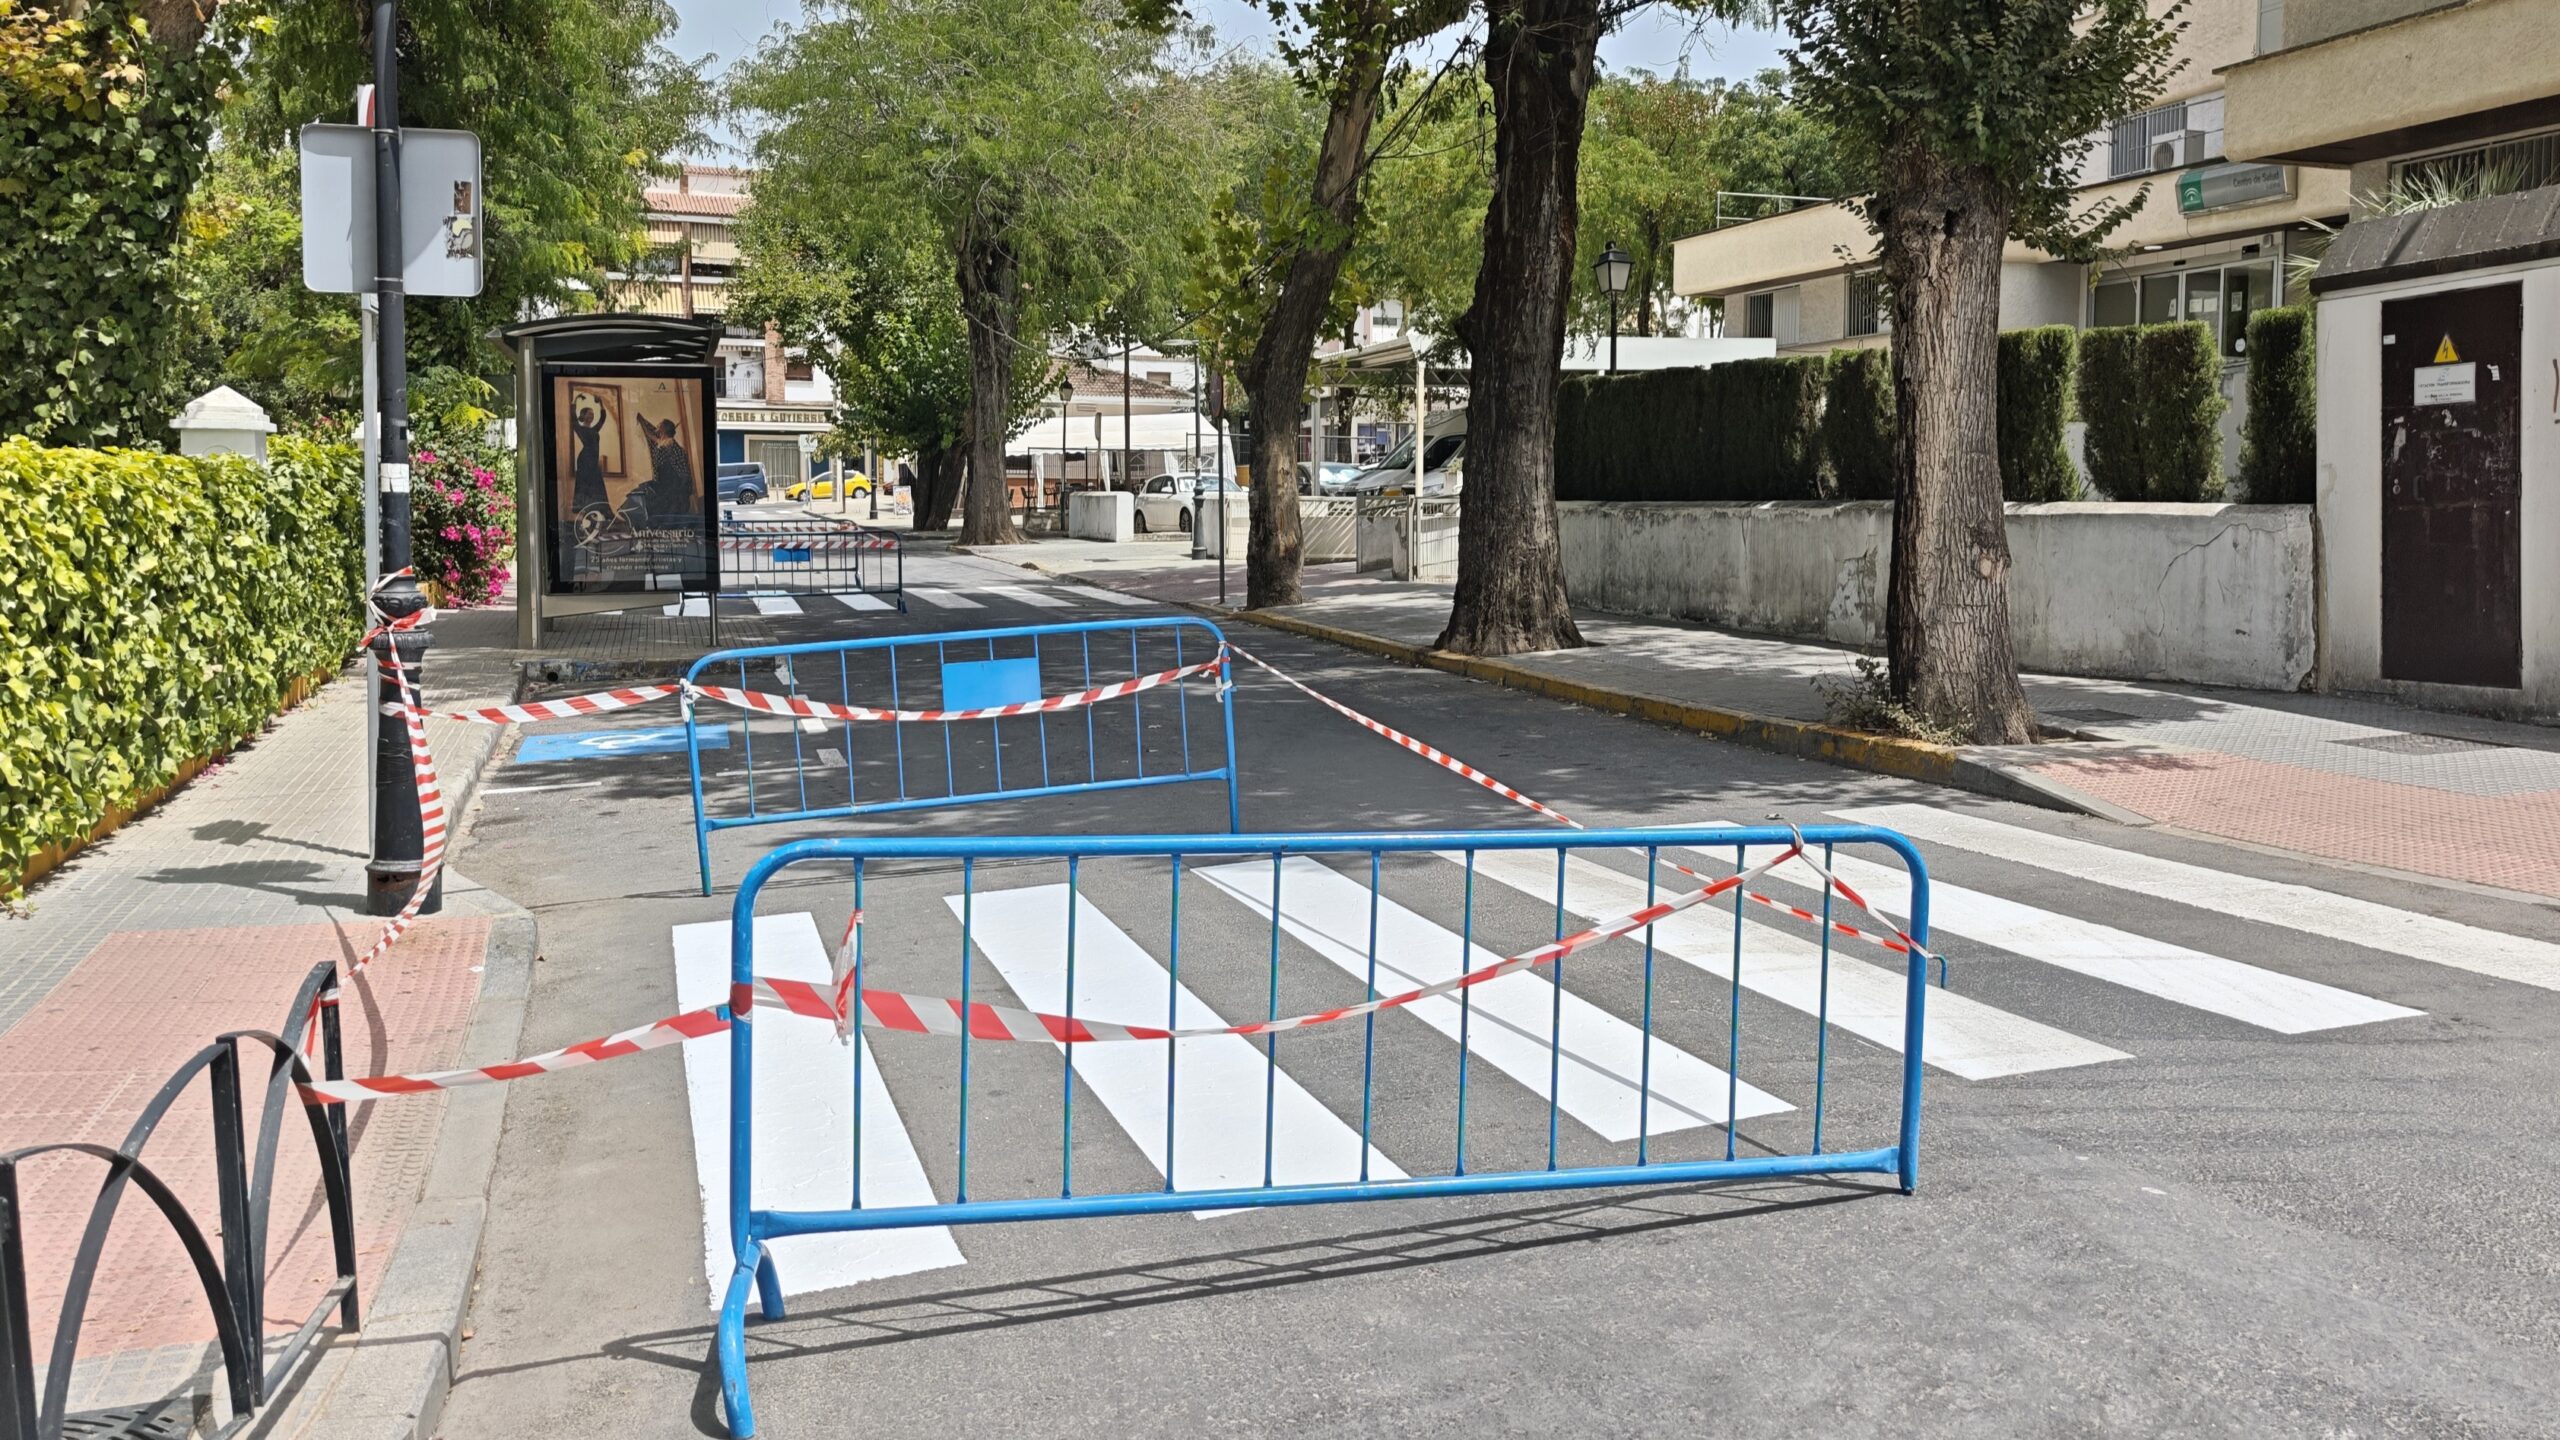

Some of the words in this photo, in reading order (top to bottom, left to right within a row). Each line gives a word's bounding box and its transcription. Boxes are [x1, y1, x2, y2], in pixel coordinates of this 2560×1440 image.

[2253, 173, 2261, 184] de
[770, 412, 826, 422] GUTIERRE
[631, 527, 694, 538] Aniversario
